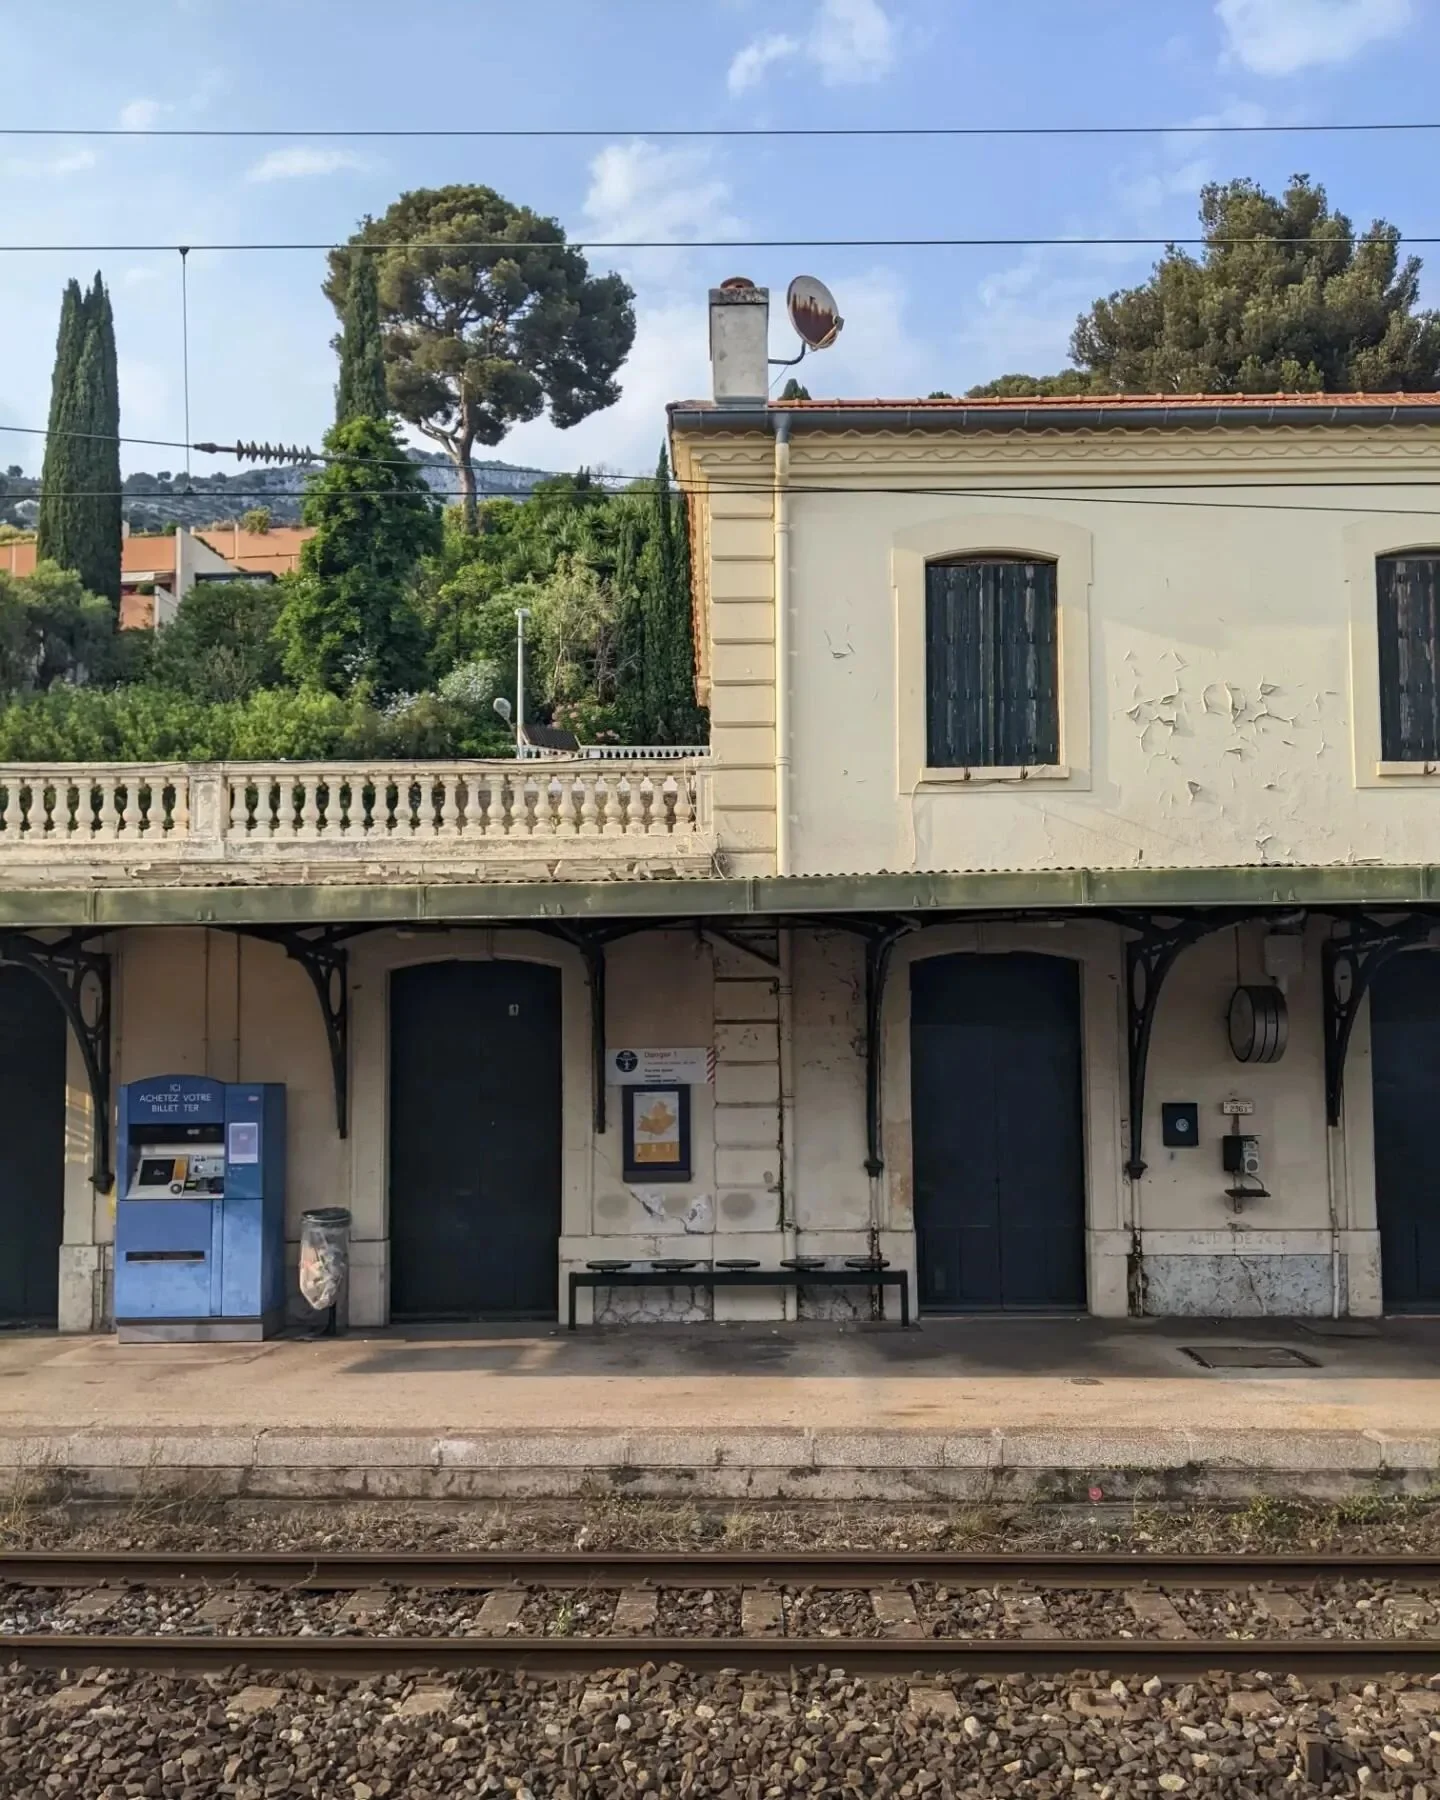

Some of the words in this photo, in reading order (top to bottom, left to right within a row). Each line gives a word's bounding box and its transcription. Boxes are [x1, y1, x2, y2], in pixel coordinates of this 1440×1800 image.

[169, 1084, 180, 1092] ICI
[139, 1093, 179, 1102] ACHETEZ
[183, 1093, 212, 1102] VOTRE
[151, 1104, 179, 1112] BILLET
[183, 1104, 199, 1112] TER
